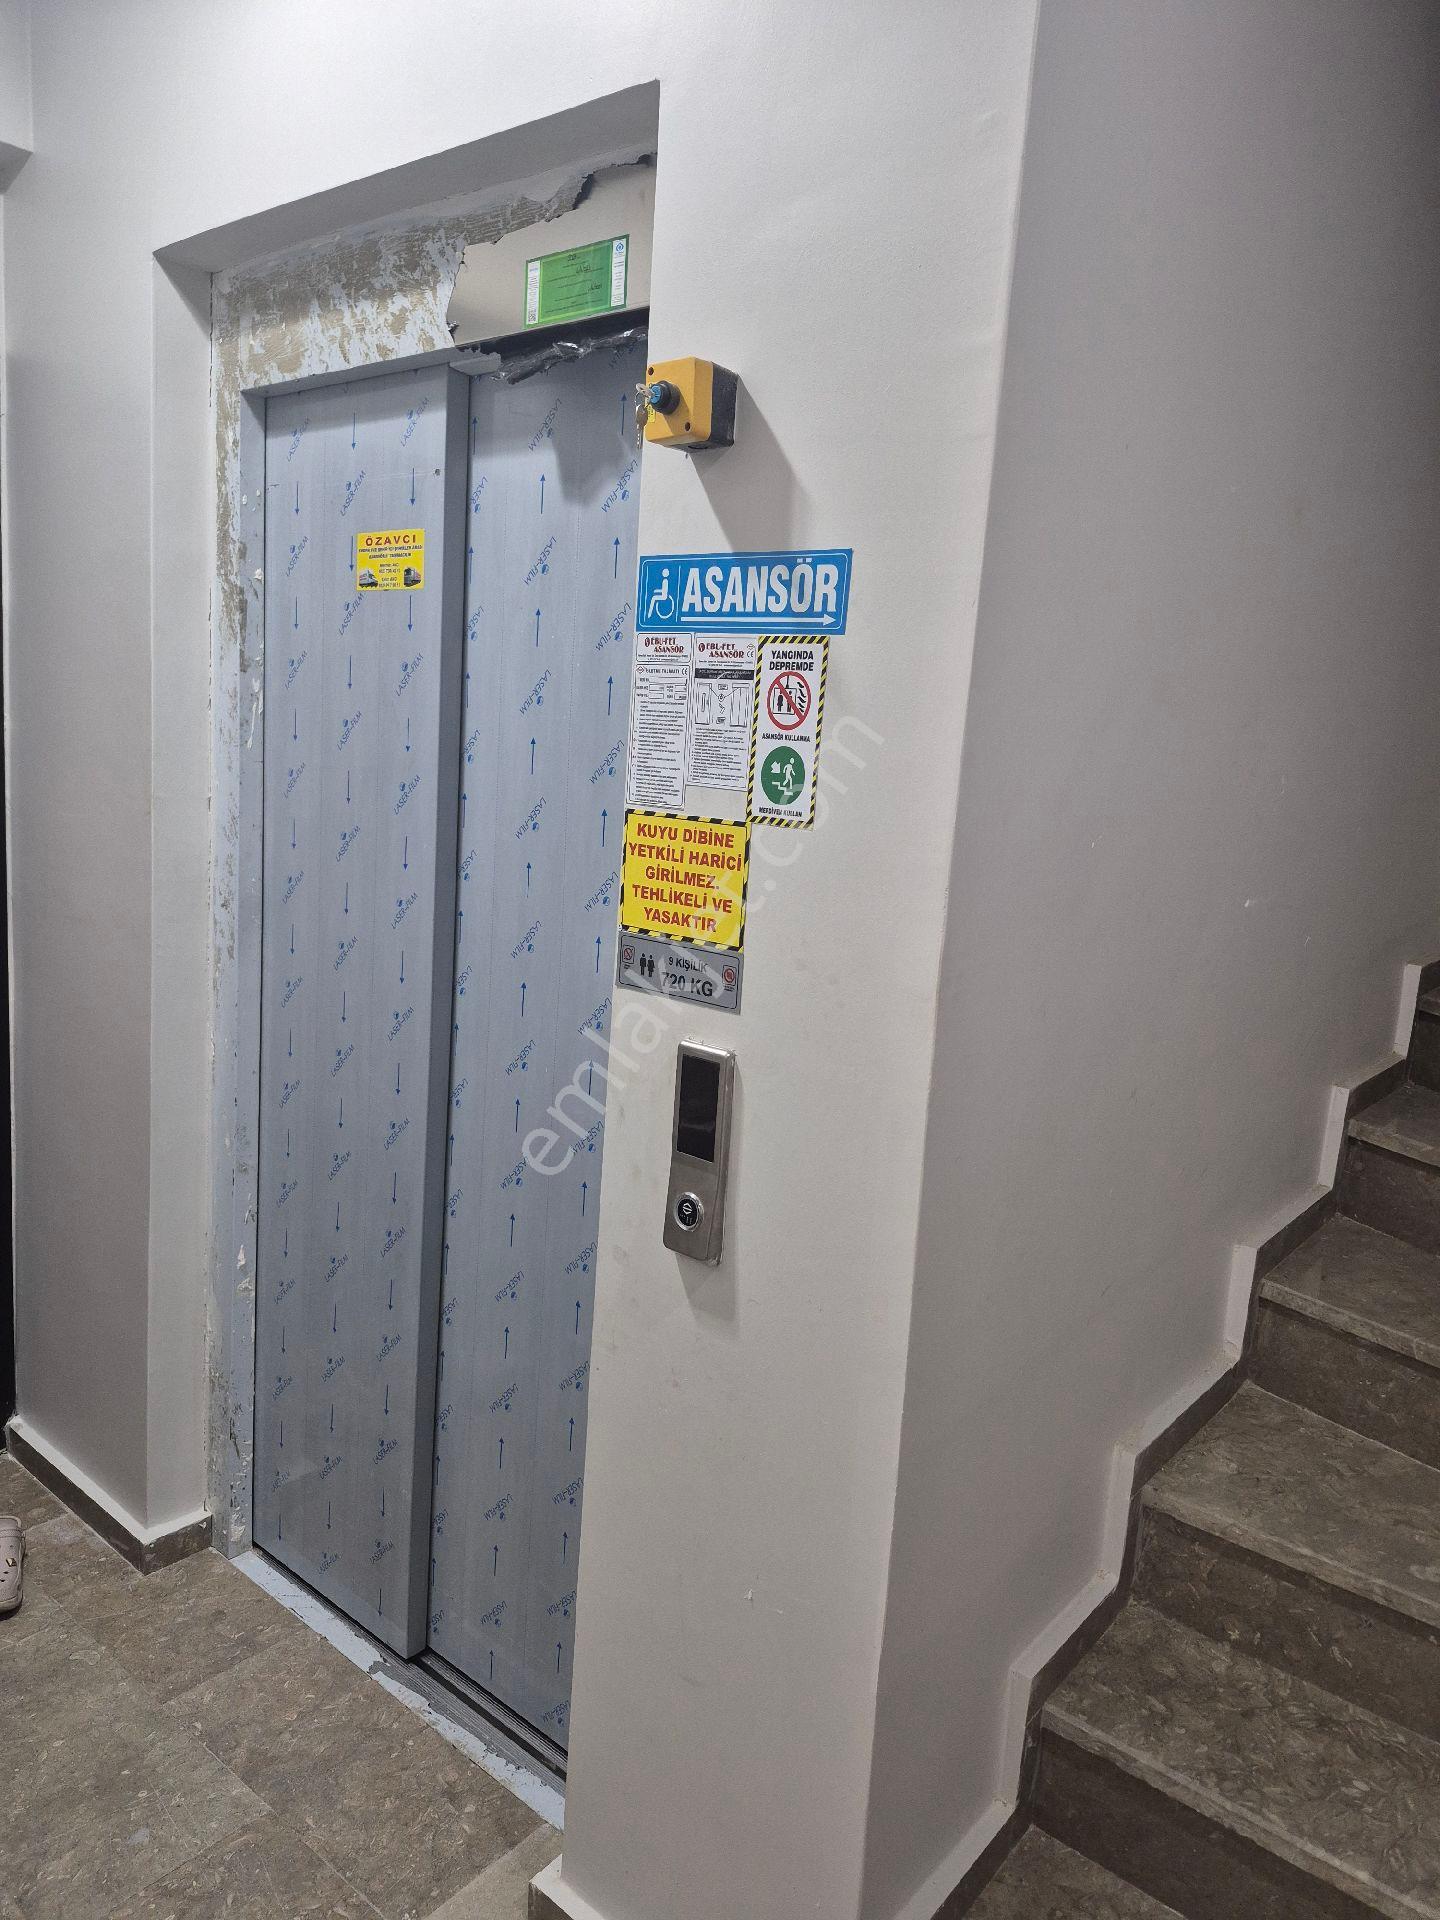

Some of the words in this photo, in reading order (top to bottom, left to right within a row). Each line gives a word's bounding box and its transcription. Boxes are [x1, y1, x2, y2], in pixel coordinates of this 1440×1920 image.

[528, 398, 562, 452] LASER-FILM
[340, 470, 367, 517] LASER-FILM
[601, 460, 639, 513] LASER-FILM
[365, 534, 416, 546] ÖZAVCI
[522, 536, 557, 585] LASER-FILM
[681, 557, 839, 613] ASANSÖR
[595, 603, 632, 651] LASER-FILM
[708, 649, 744, 659] ASANSÖR
[769, 661, 814, 671] DEPREMDE
[771, 650, 814, 660] YANGINDA
[396, 653, 424, 697] LASER-FILM
[519, 668, 552, 716] LASER-FILM
[762, 732, 784, 740] ASANSÖR
[784, 735, 811, 743] KULLANMA
[589, 739, 625, 785] LASER-FILM
[394, 775, 421, 815] LASER-FILM
[514, 797, 547, 840] LASER-FILM
[637, 823, 678, 841] KUYU
[683, 828, 735, 849] DİBİNE
[629, 842, 684, 864] YETKİLİ
[688, 852, 742, 872] HARİCİ
[584, 871, 619, 912] LASER-FILM
[645, 865, 720, 890] GİRİLMEZ.
[391, 892, 419, 930] LASER-FILM
[632, 884, 707, 910] TEHLİKELİ
[712, 897, 733, 914] VE
[643, 906, 717, 932] YASAKTIR
[510, 920, 542, 959] LASER-FILM
[668, 957, 674, 965] 9
[661, 972, 686, 991] 720
[691, 977, 713, 997] KG
[387, 1007, 415, 1042] LASER-FILM
[578, 998, 612, 1035] LASER-FILM
[505, 1039, 536, 1077] LASER-FILM
[380, 1226, 407, 1258] LASER-FILM
[564, 1242, 598, 1275] LASER-FILM
[494, 1270, 525, 1302] LASER-FILM
[558, 1361, 590, 1391] LASER-FILM
[489, 1383, 519, 1413] LASER-FILM
